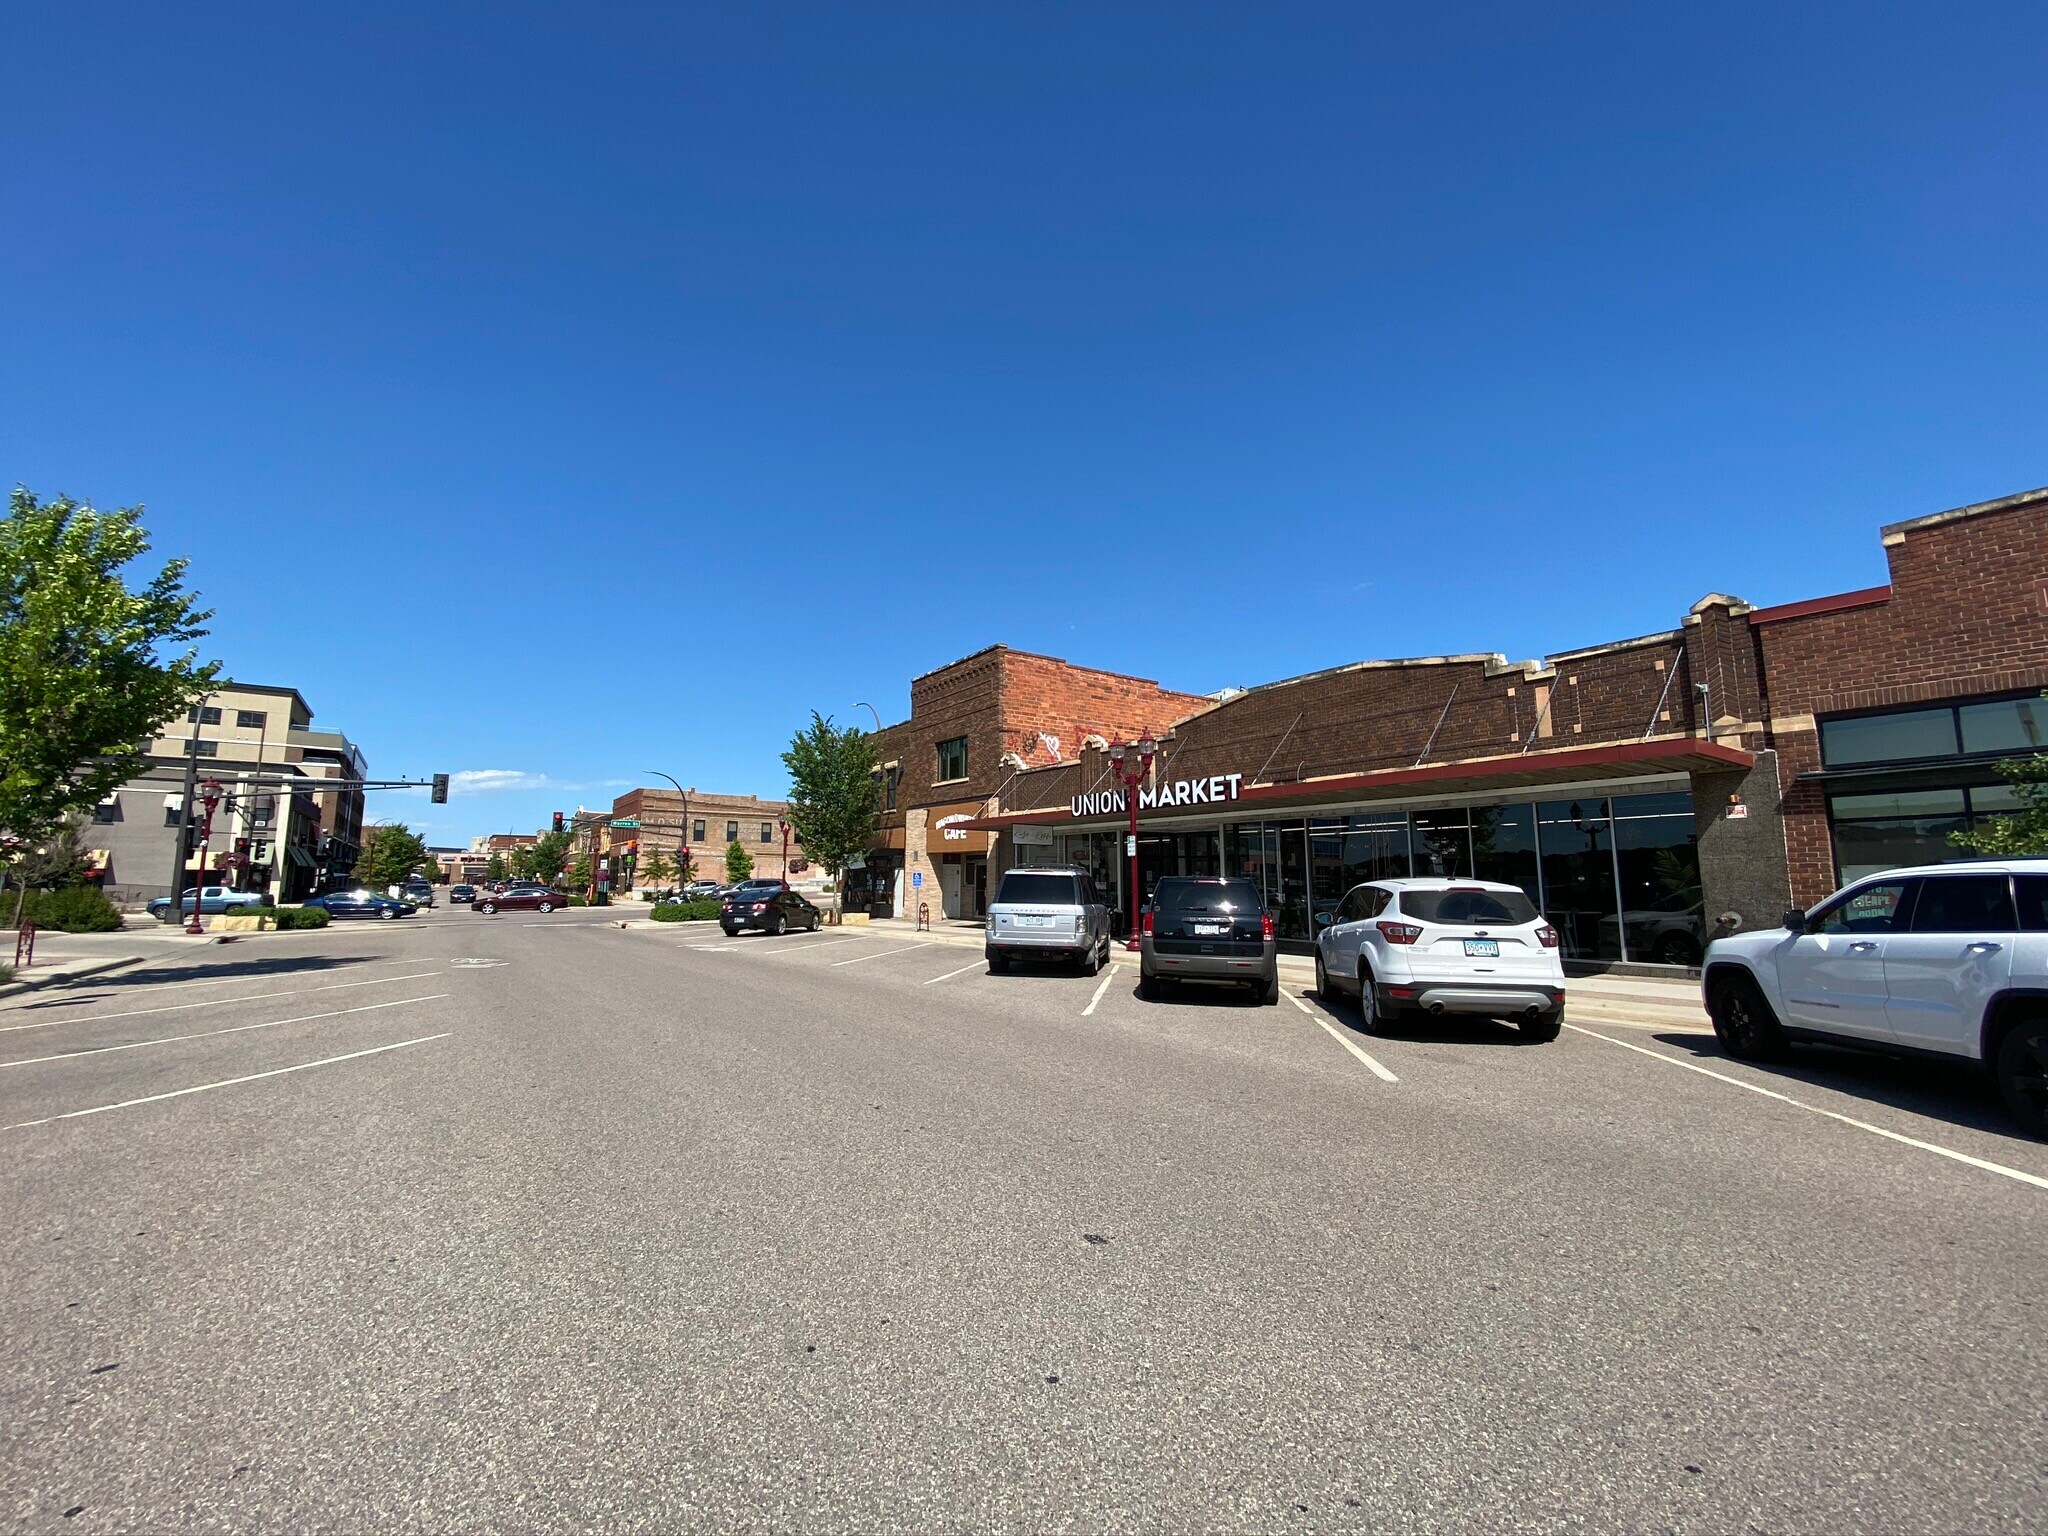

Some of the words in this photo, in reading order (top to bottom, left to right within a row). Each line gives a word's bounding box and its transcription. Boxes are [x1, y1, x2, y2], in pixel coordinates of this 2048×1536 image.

[1071, 789, 1126, 816] UNION
[1139, 773, 1242, 809] MARKET
[944, 828, 967, 840] CAFE
[1851, 895, 1890, 908] ESCAPE
